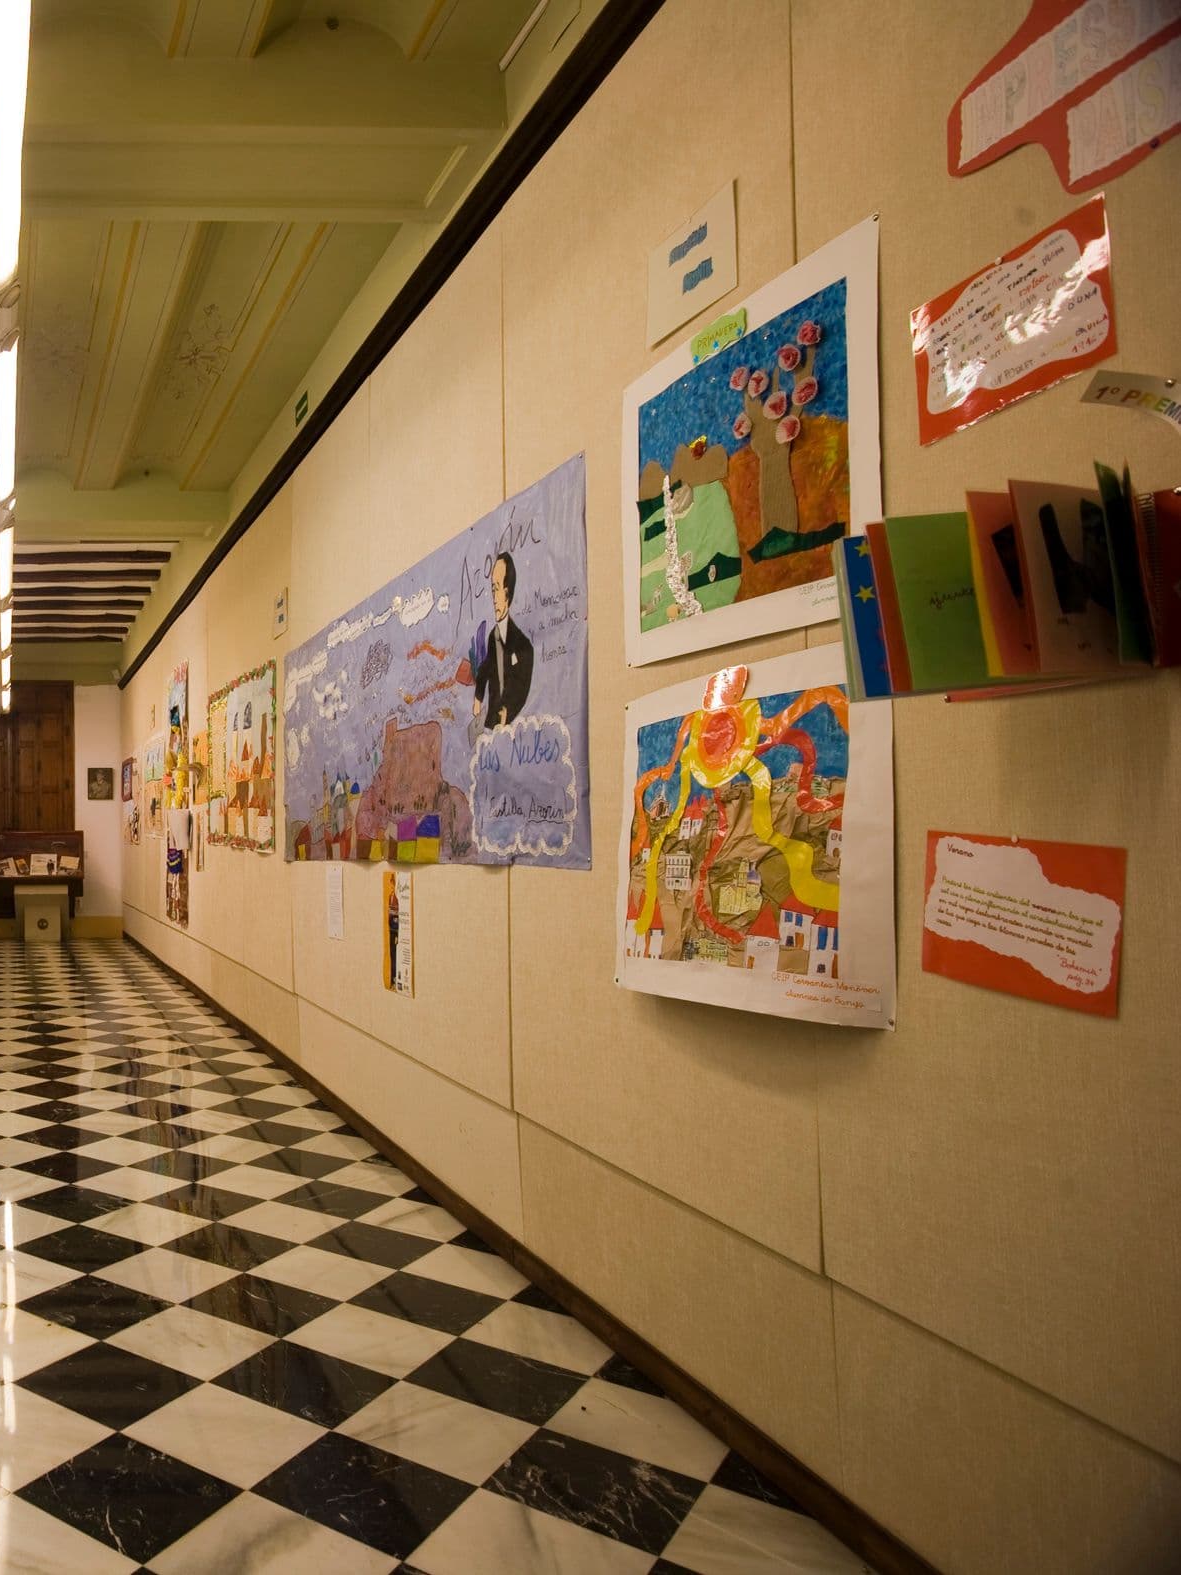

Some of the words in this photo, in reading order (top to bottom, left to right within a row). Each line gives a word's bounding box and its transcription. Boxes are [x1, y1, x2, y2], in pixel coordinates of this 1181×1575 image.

[697, 320, 739, 354] PRIMAVERA
[510, 730, 560, 767] Nubes
[947, 843, 974, 858] Verano
[1019, 898, 1030, 907] del
[1081, 917, 1094, 926] que
